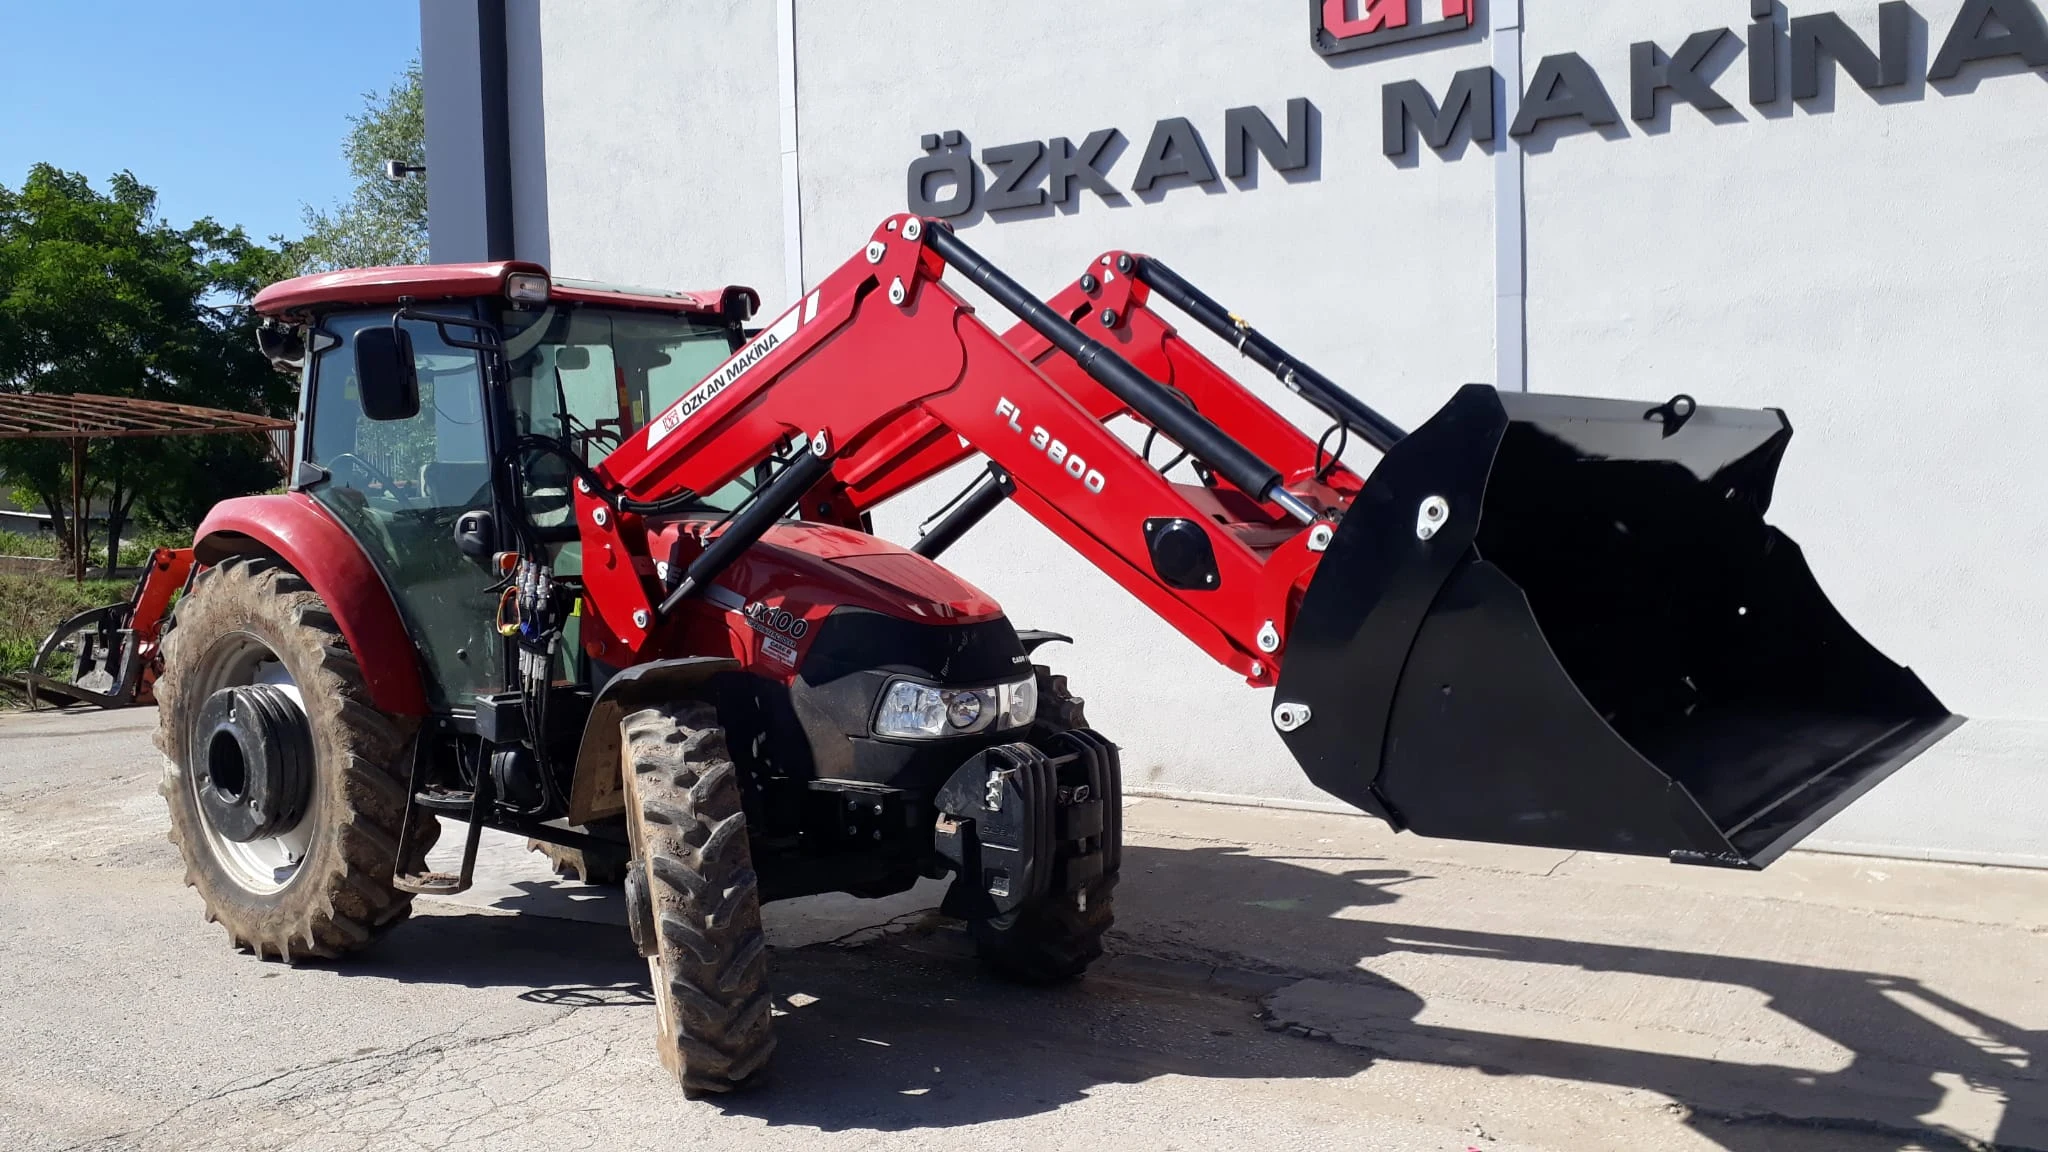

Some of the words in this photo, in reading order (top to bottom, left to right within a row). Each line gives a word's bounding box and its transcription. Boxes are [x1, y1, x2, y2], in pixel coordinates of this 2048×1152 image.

[907, 97, 1309, 217] ÖZKAN
[1381, 0, 2048, 157] MAKİNA
[681, 374, 726, 417] ÖZKAN
[725, 332, 780, 382] MAKİNA
[994, 396, 1023, 434] FL
[1029, 425, 1106, 495] 3800
[744, 601, 808, 639] JX100
